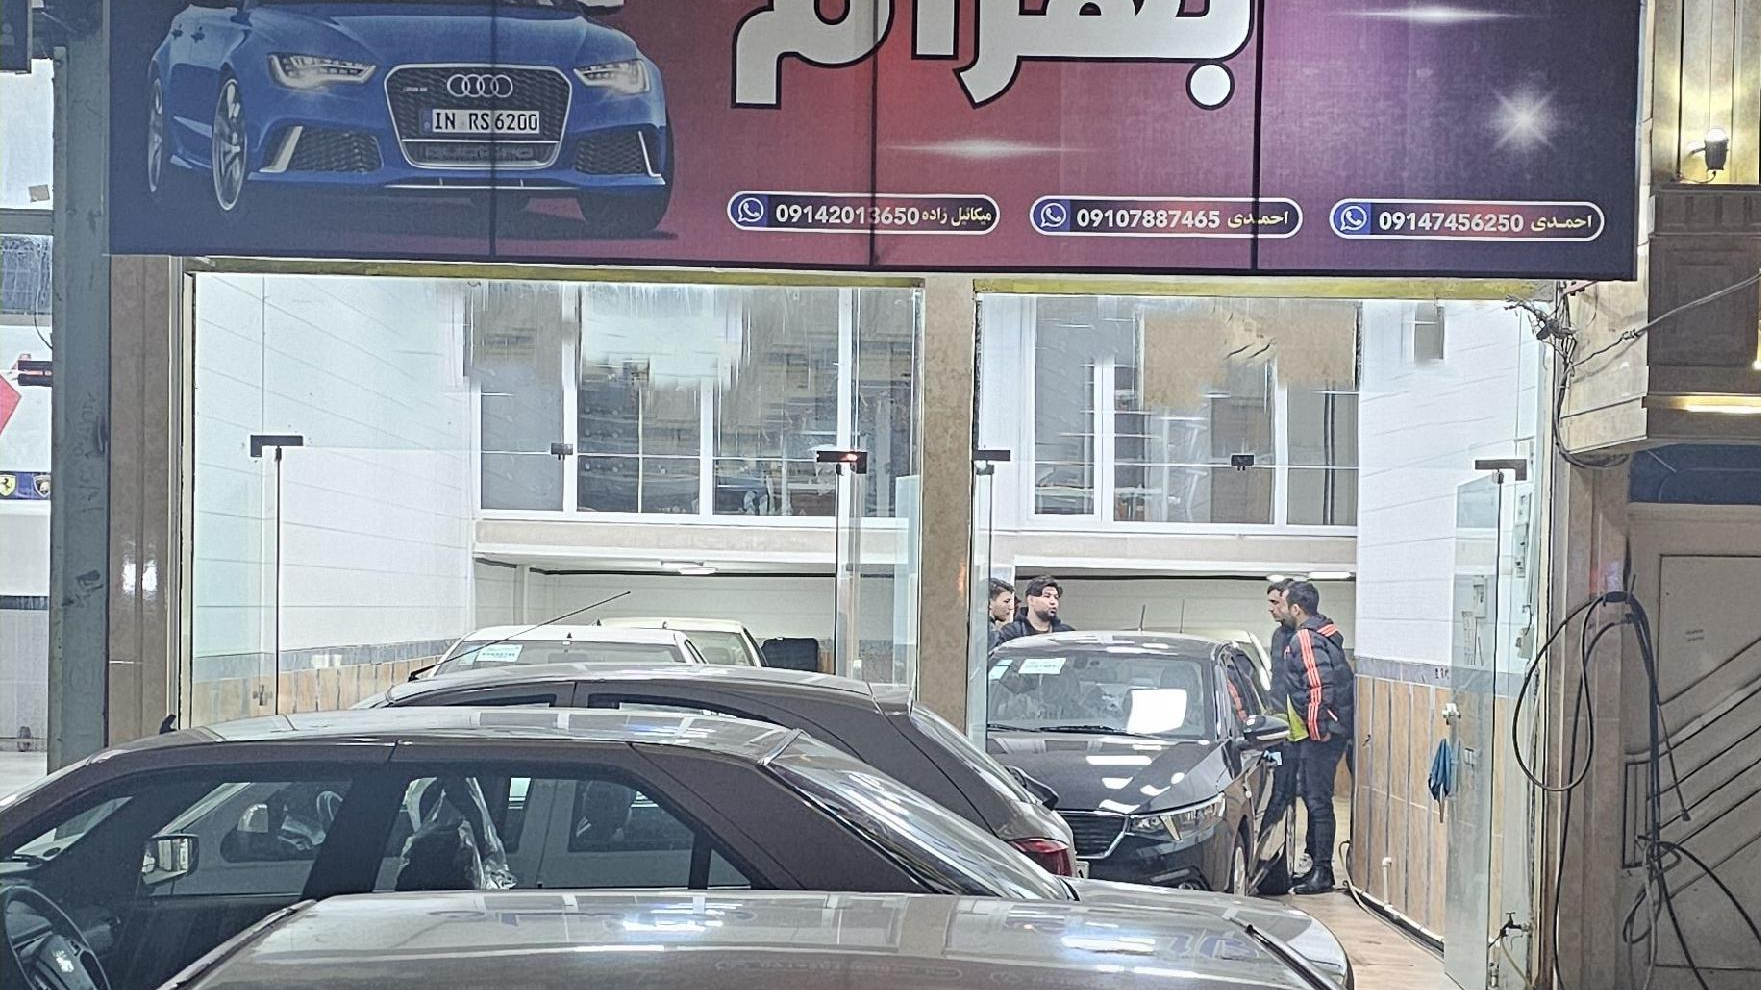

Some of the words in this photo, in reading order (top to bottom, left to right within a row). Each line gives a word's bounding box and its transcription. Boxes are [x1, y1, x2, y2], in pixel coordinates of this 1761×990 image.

[434, 112, 456, 130] IN
[775, 204, 920, 225] 09142013650
[921, 206, 948, 225] زاده
[950, 206, 992, 227] میکائیل
[1076, 208, 1221, 229] 09107887465
[1227, 211, 1289, 229] احمدی
[1378, 211, 1525, 232] 09147456250
[1530, 214, 1592, 232] احمدی
